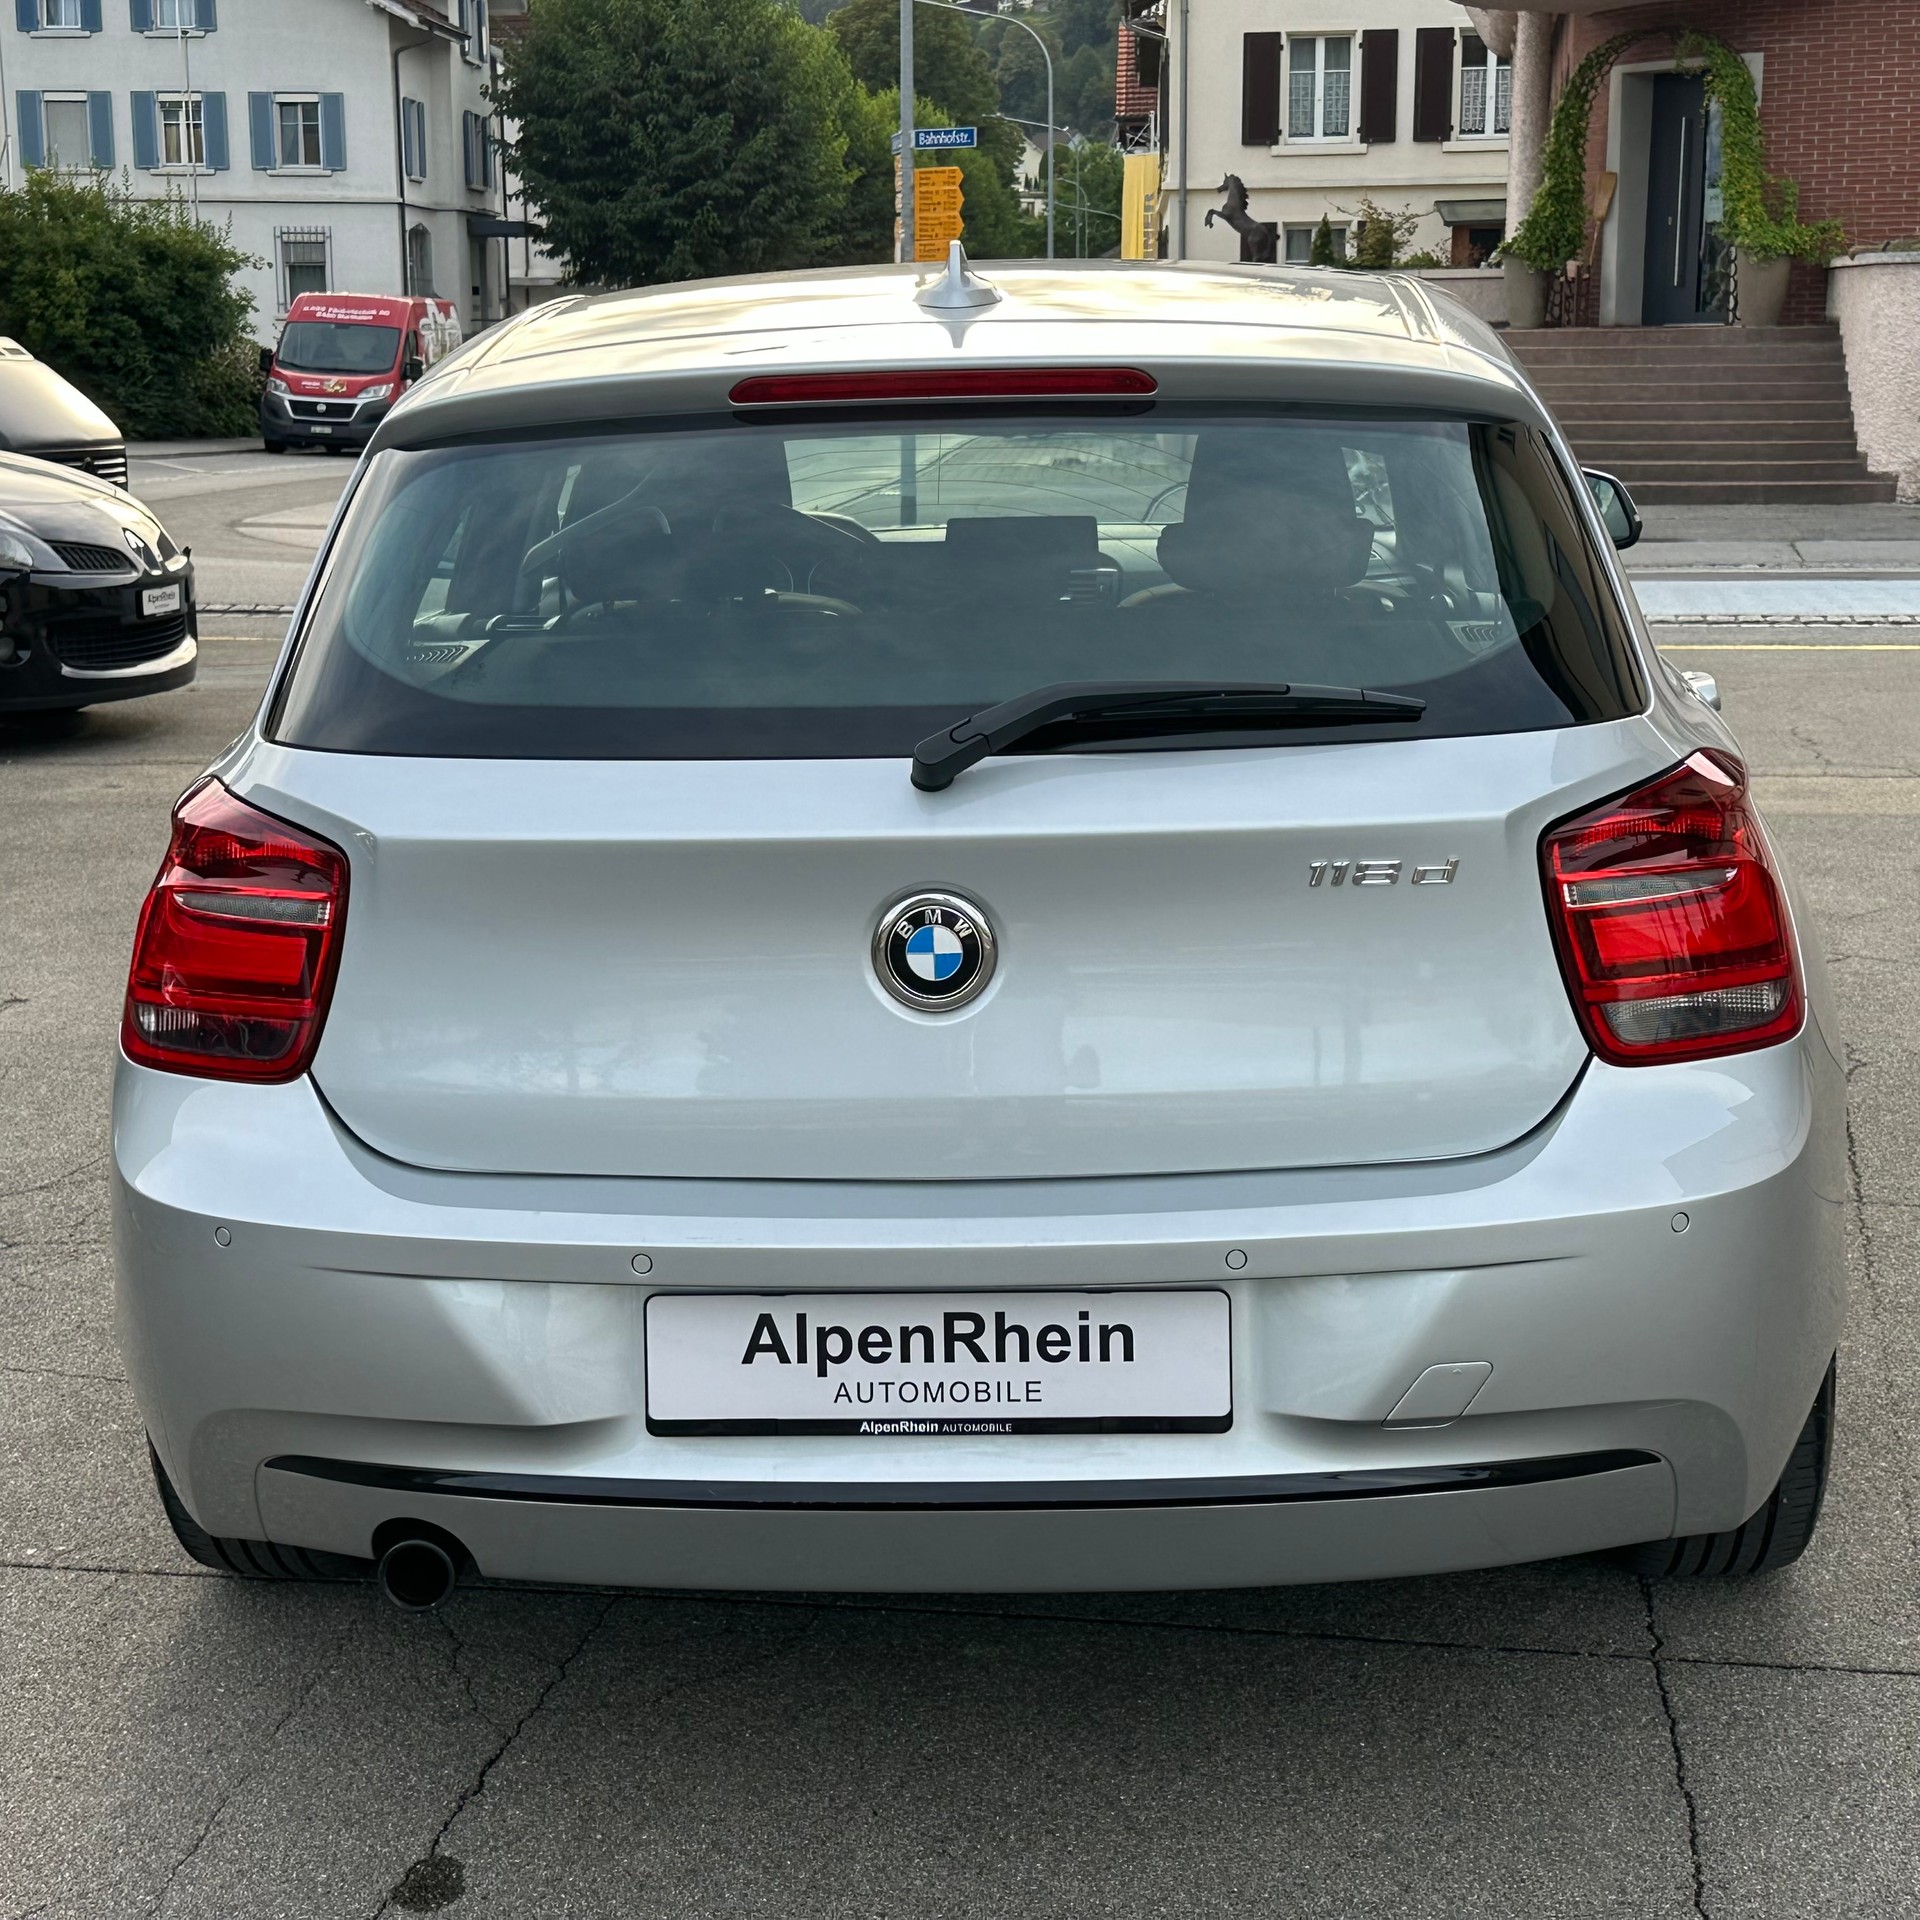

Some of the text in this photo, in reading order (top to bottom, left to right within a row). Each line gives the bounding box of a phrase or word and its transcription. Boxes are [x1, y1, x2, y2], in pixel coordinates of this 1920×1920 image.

[919, 131, 971, 145] Bahnhofstr.
[1309, 855, 1460, 888] 118 d
[896, 909, 973, 940] BMW
[741, 1310, 1135, 1378] AlpenRhein
[833, 1380, 1042, 1404] AUTOMOBILE
[860, 1421, 1012, 1434] AlpenRhein AUTOMOBILE
